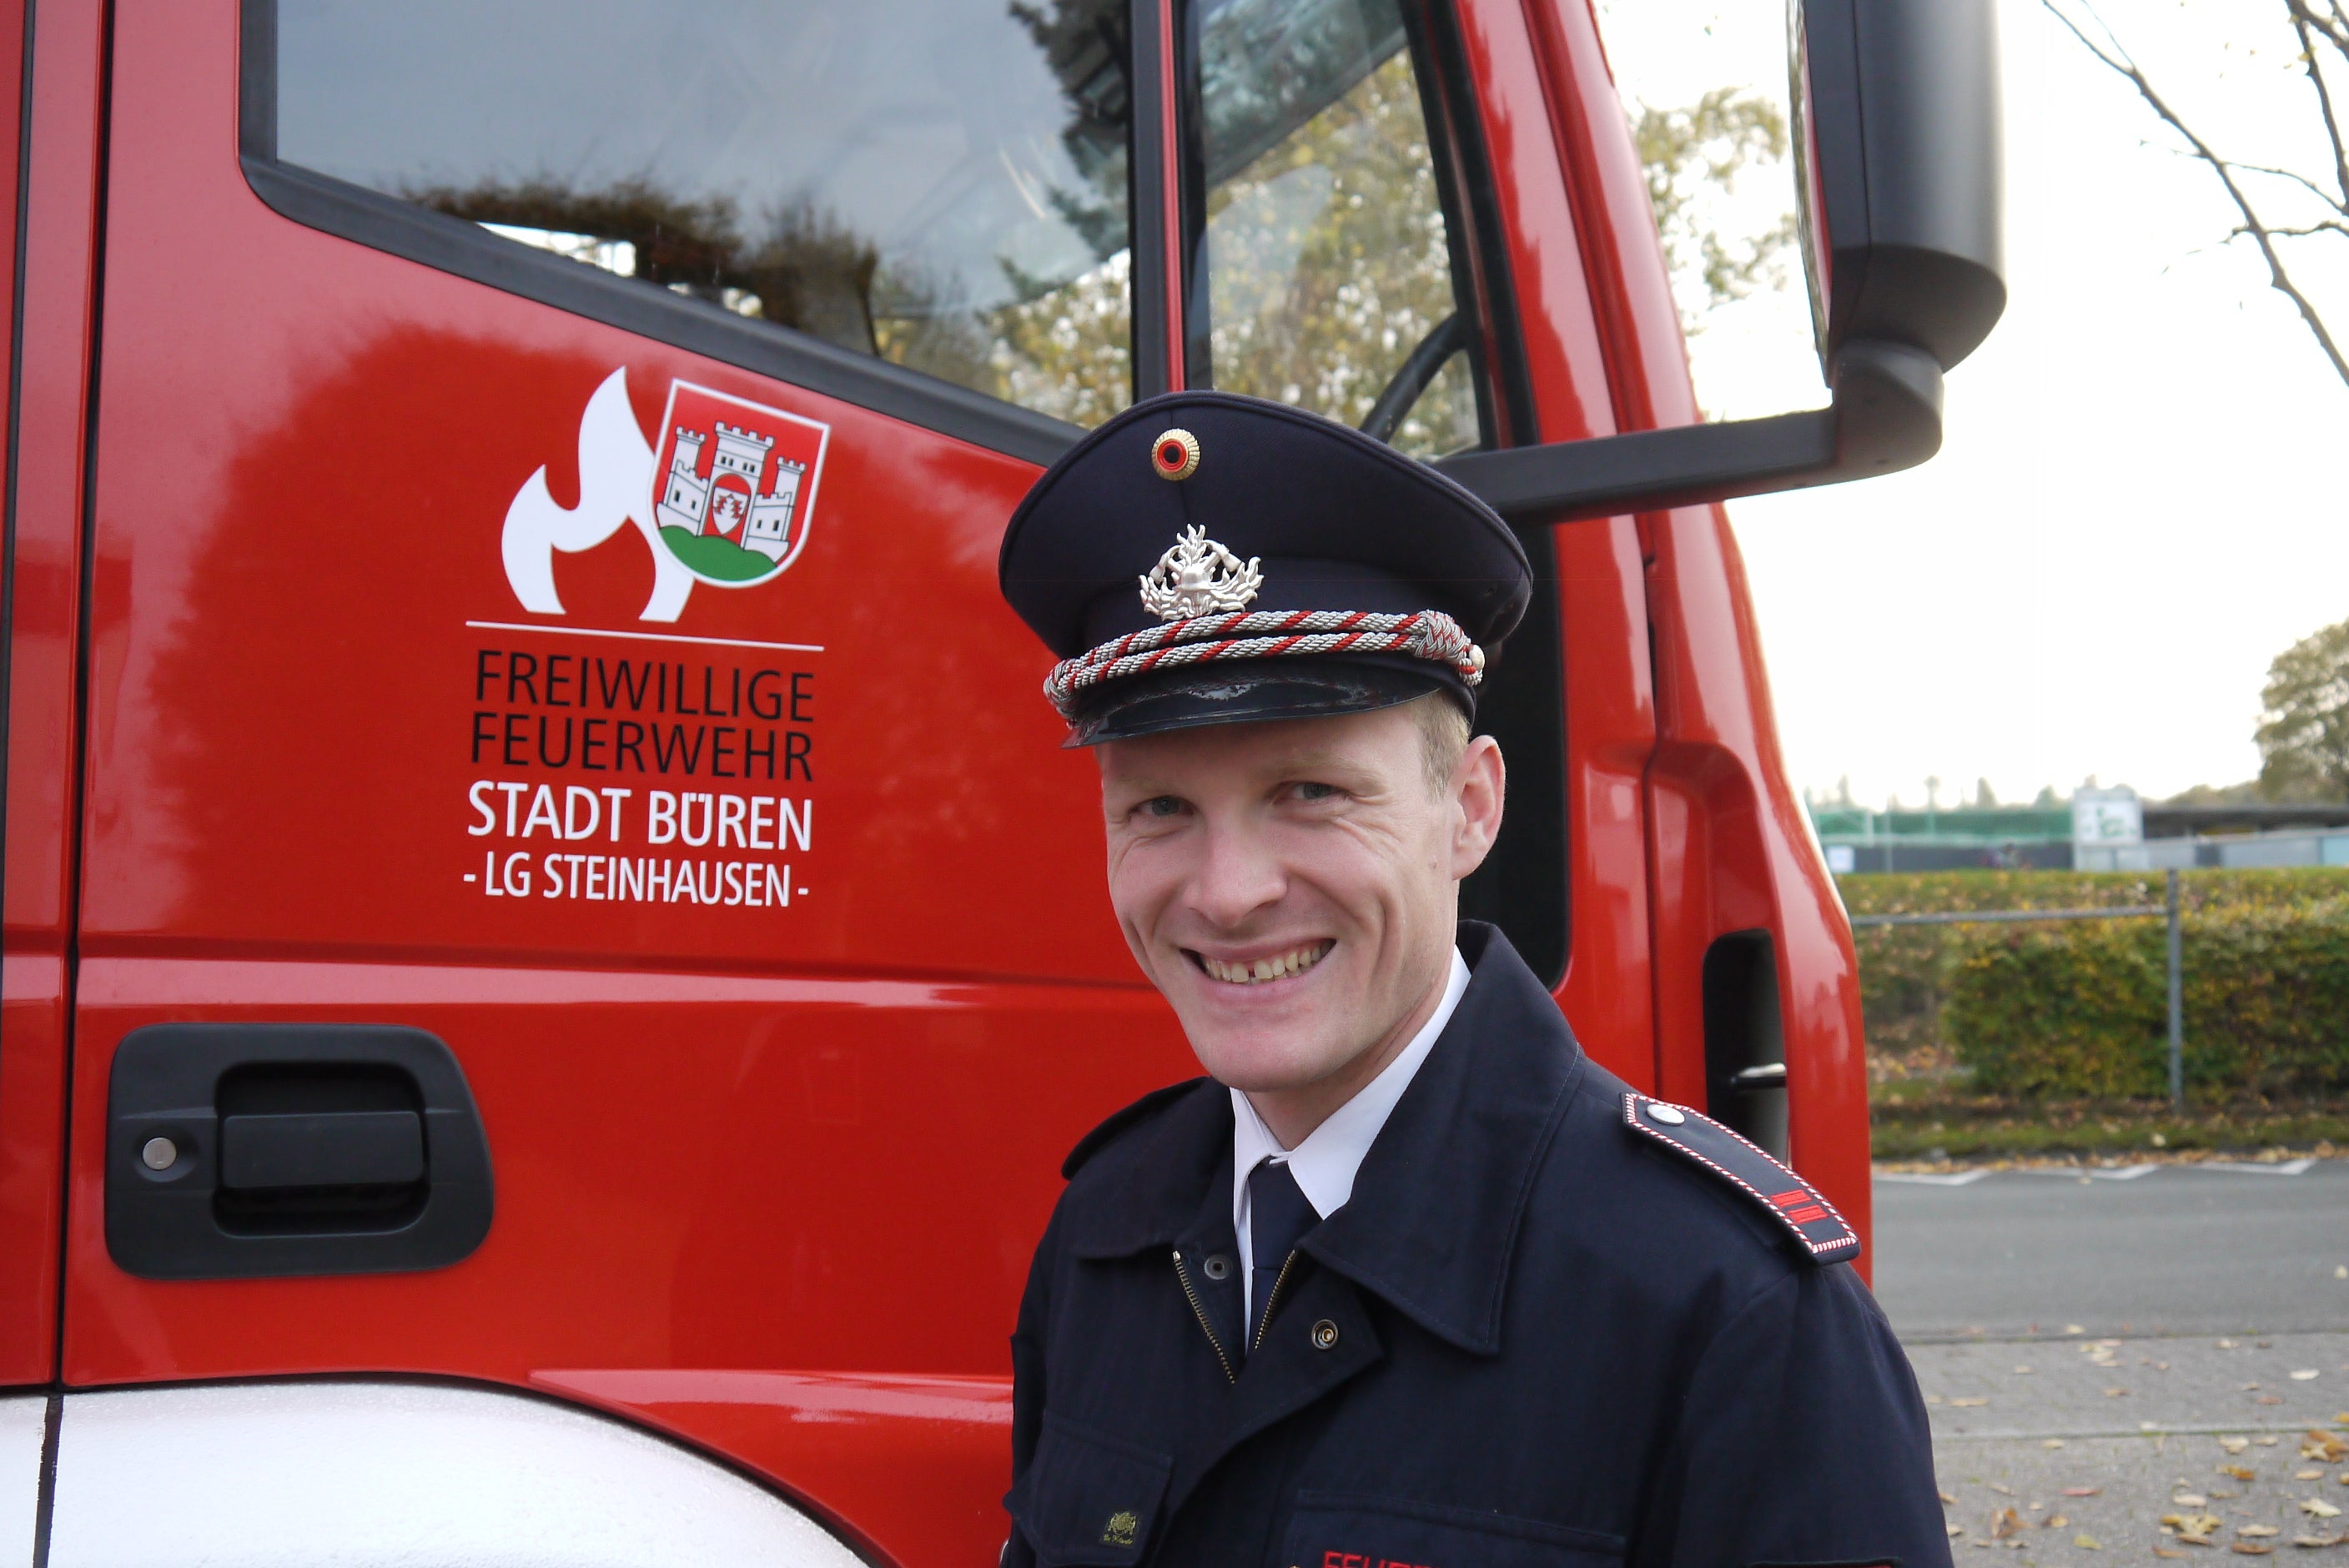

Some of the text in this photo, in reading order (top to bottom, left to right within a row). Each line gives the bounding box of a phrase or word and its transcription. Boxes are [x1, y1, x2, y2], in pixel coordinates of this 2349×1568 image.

[476, 650, 814, 722] FREIWILLIGE
[471, 711, 813, 781] FEUERWEHR
[468, 780, 812, 852] STADT BÜREN
